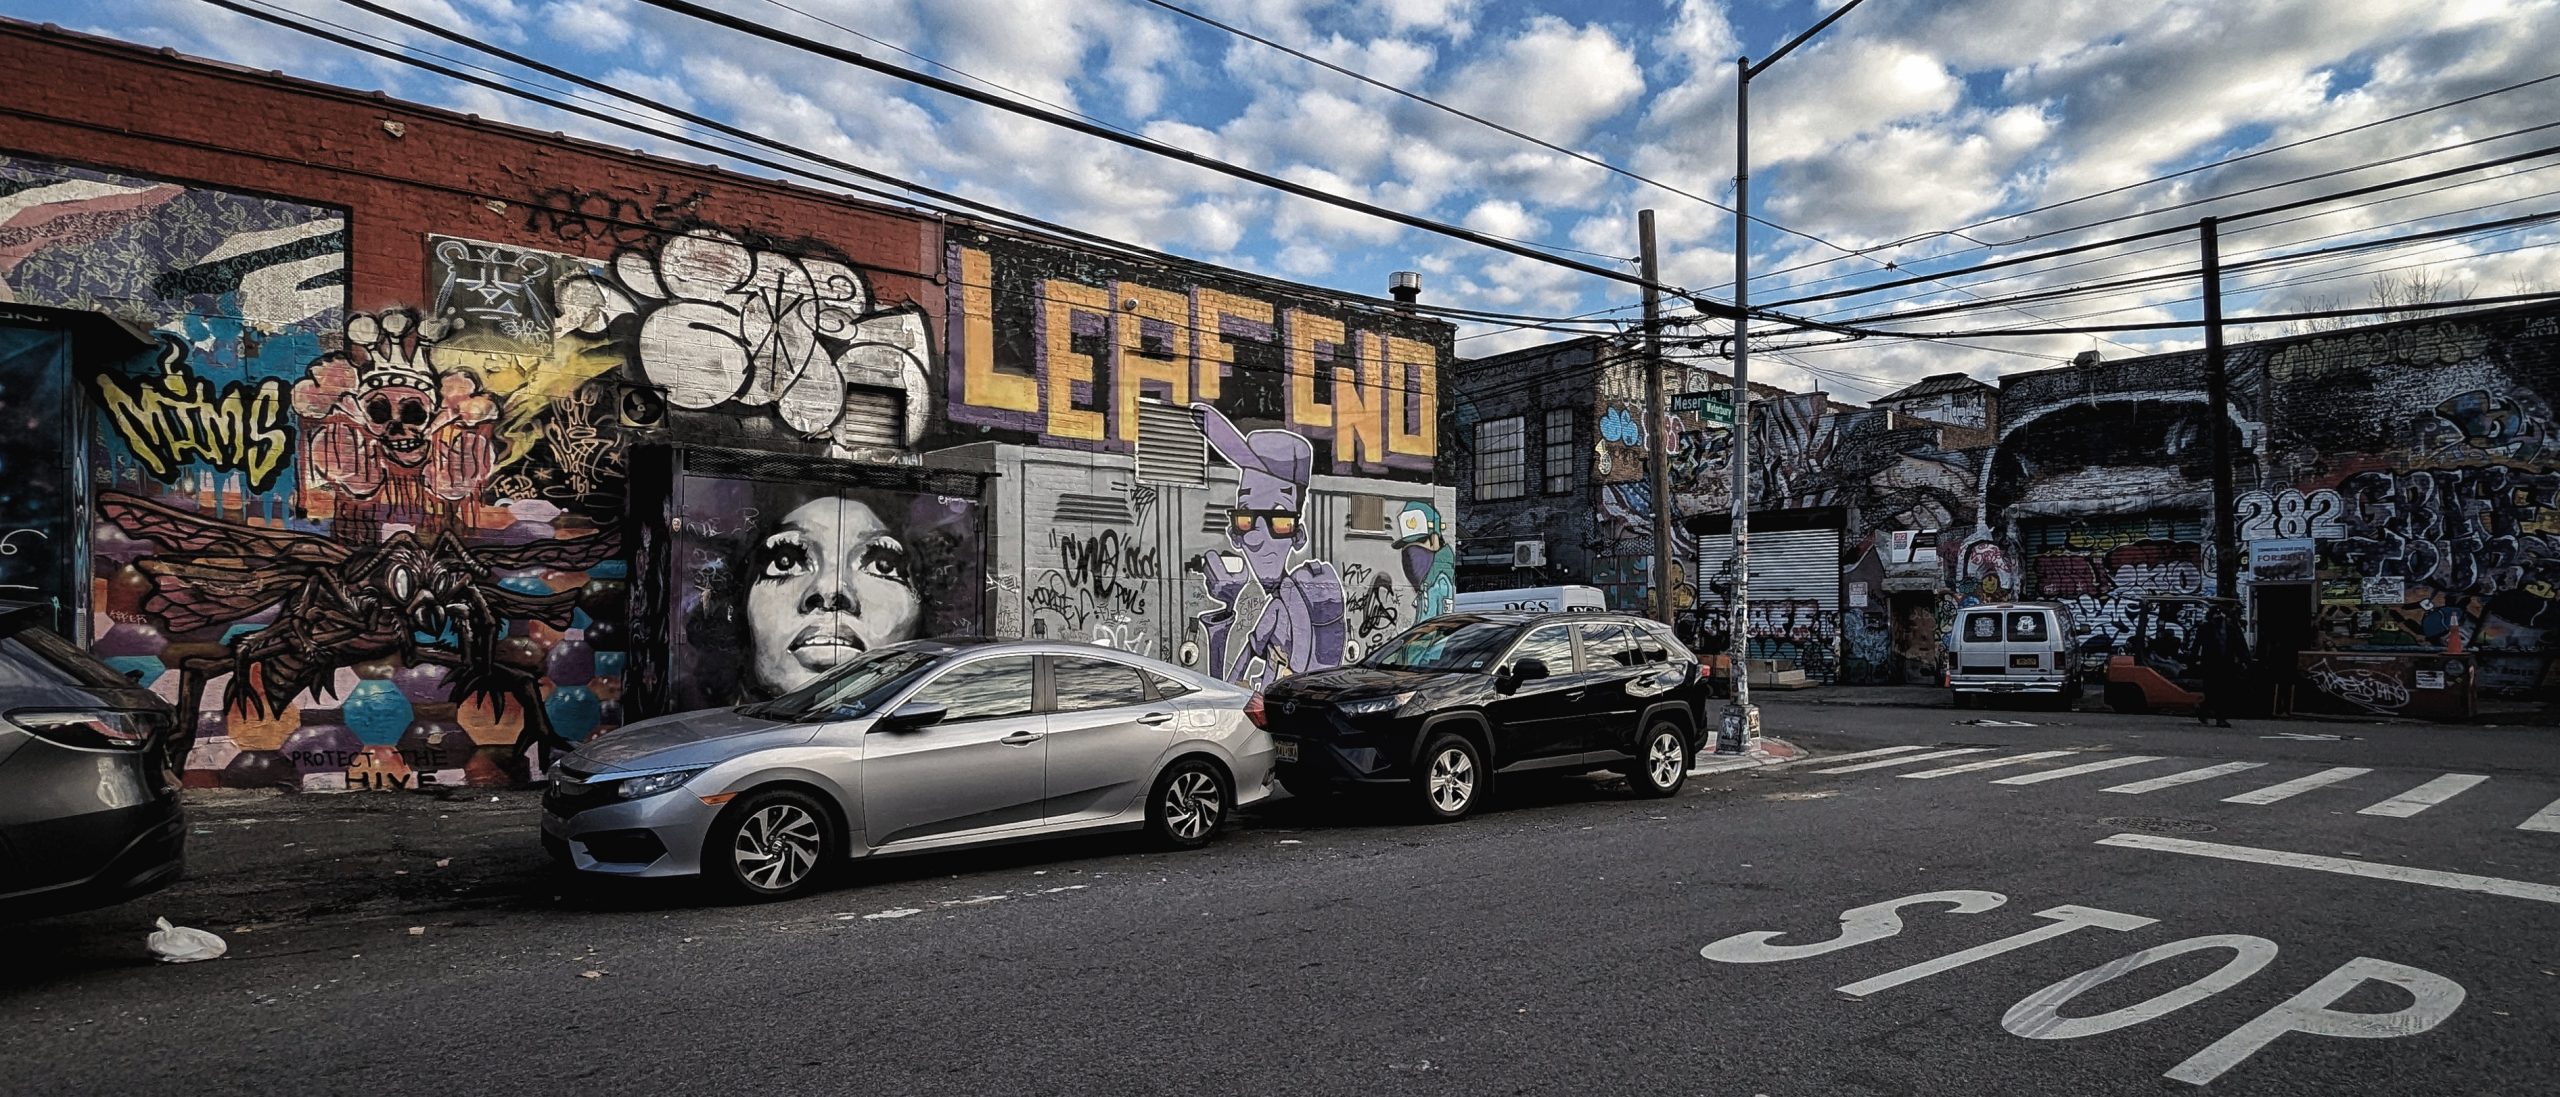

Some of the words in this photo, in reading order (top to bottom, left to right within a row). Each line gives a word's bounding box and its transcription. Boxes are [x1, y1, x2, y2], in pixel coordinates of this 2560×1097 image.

[956, 246, 1281, 446] LEAF
[1706, 402, 1732, 419] Waterbury
[2233, 489, 2348, 541] 282
[2257, 554, 2276, 562] FOR
[292, 750, 374, 767] PROTECT
[392, 750, 449, 767] THE
[345, 770, 438, 792] HIVE
[1699, 888, 2466, 1085] STOP
